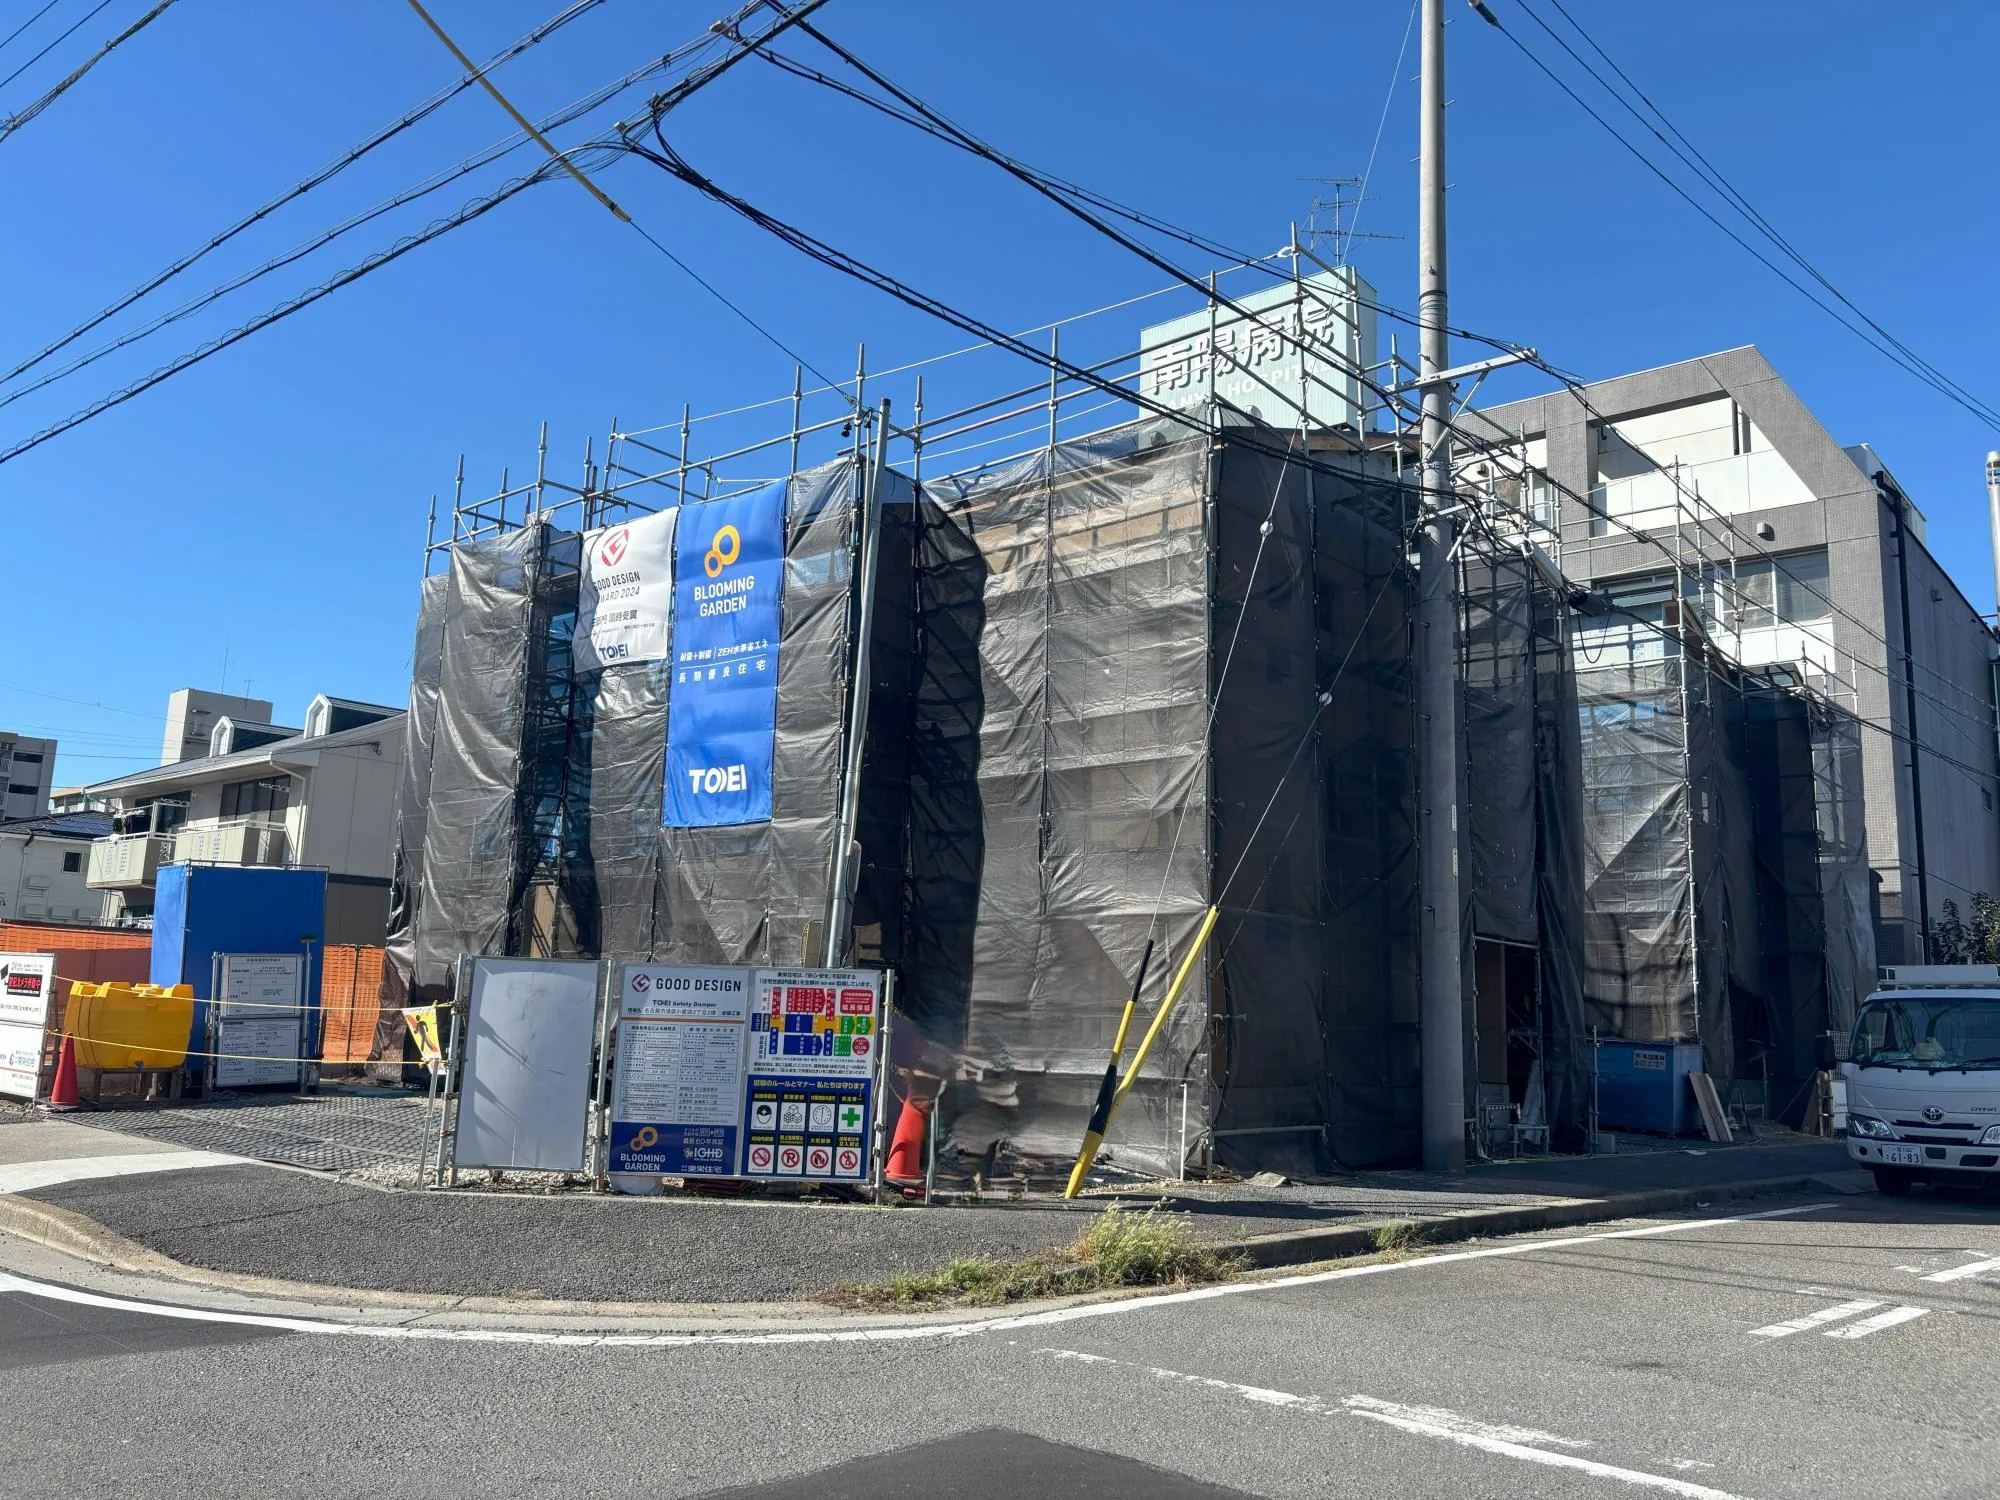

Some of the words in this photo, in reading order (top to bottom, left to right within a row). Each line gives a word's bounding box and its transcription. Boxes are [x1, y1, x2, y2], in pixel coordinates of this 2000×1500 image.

[1151, 300, 1335, 396] 南陽病院
[612, 570, 641, 587] DESIGN
[620, 585, 641, 599] 2024
[694, 575, 755, 601] BLOOMING
[700, 594, 747, 617] GARDEN
[599, 643, 629, 660] TOEI
[688, 763, 747, 794] TOEI
[655, 977, 691, 990] GOOD
[694, 979, 742, 992] DESIGN
[816, 1081, 866, 1090] 私たちは守ります
[620, 1153, 666, 1163] BLOOMING
[1891, 1153, 1919, 1163] 61-83
[624, 1162, 660, 1171] GARDEN
